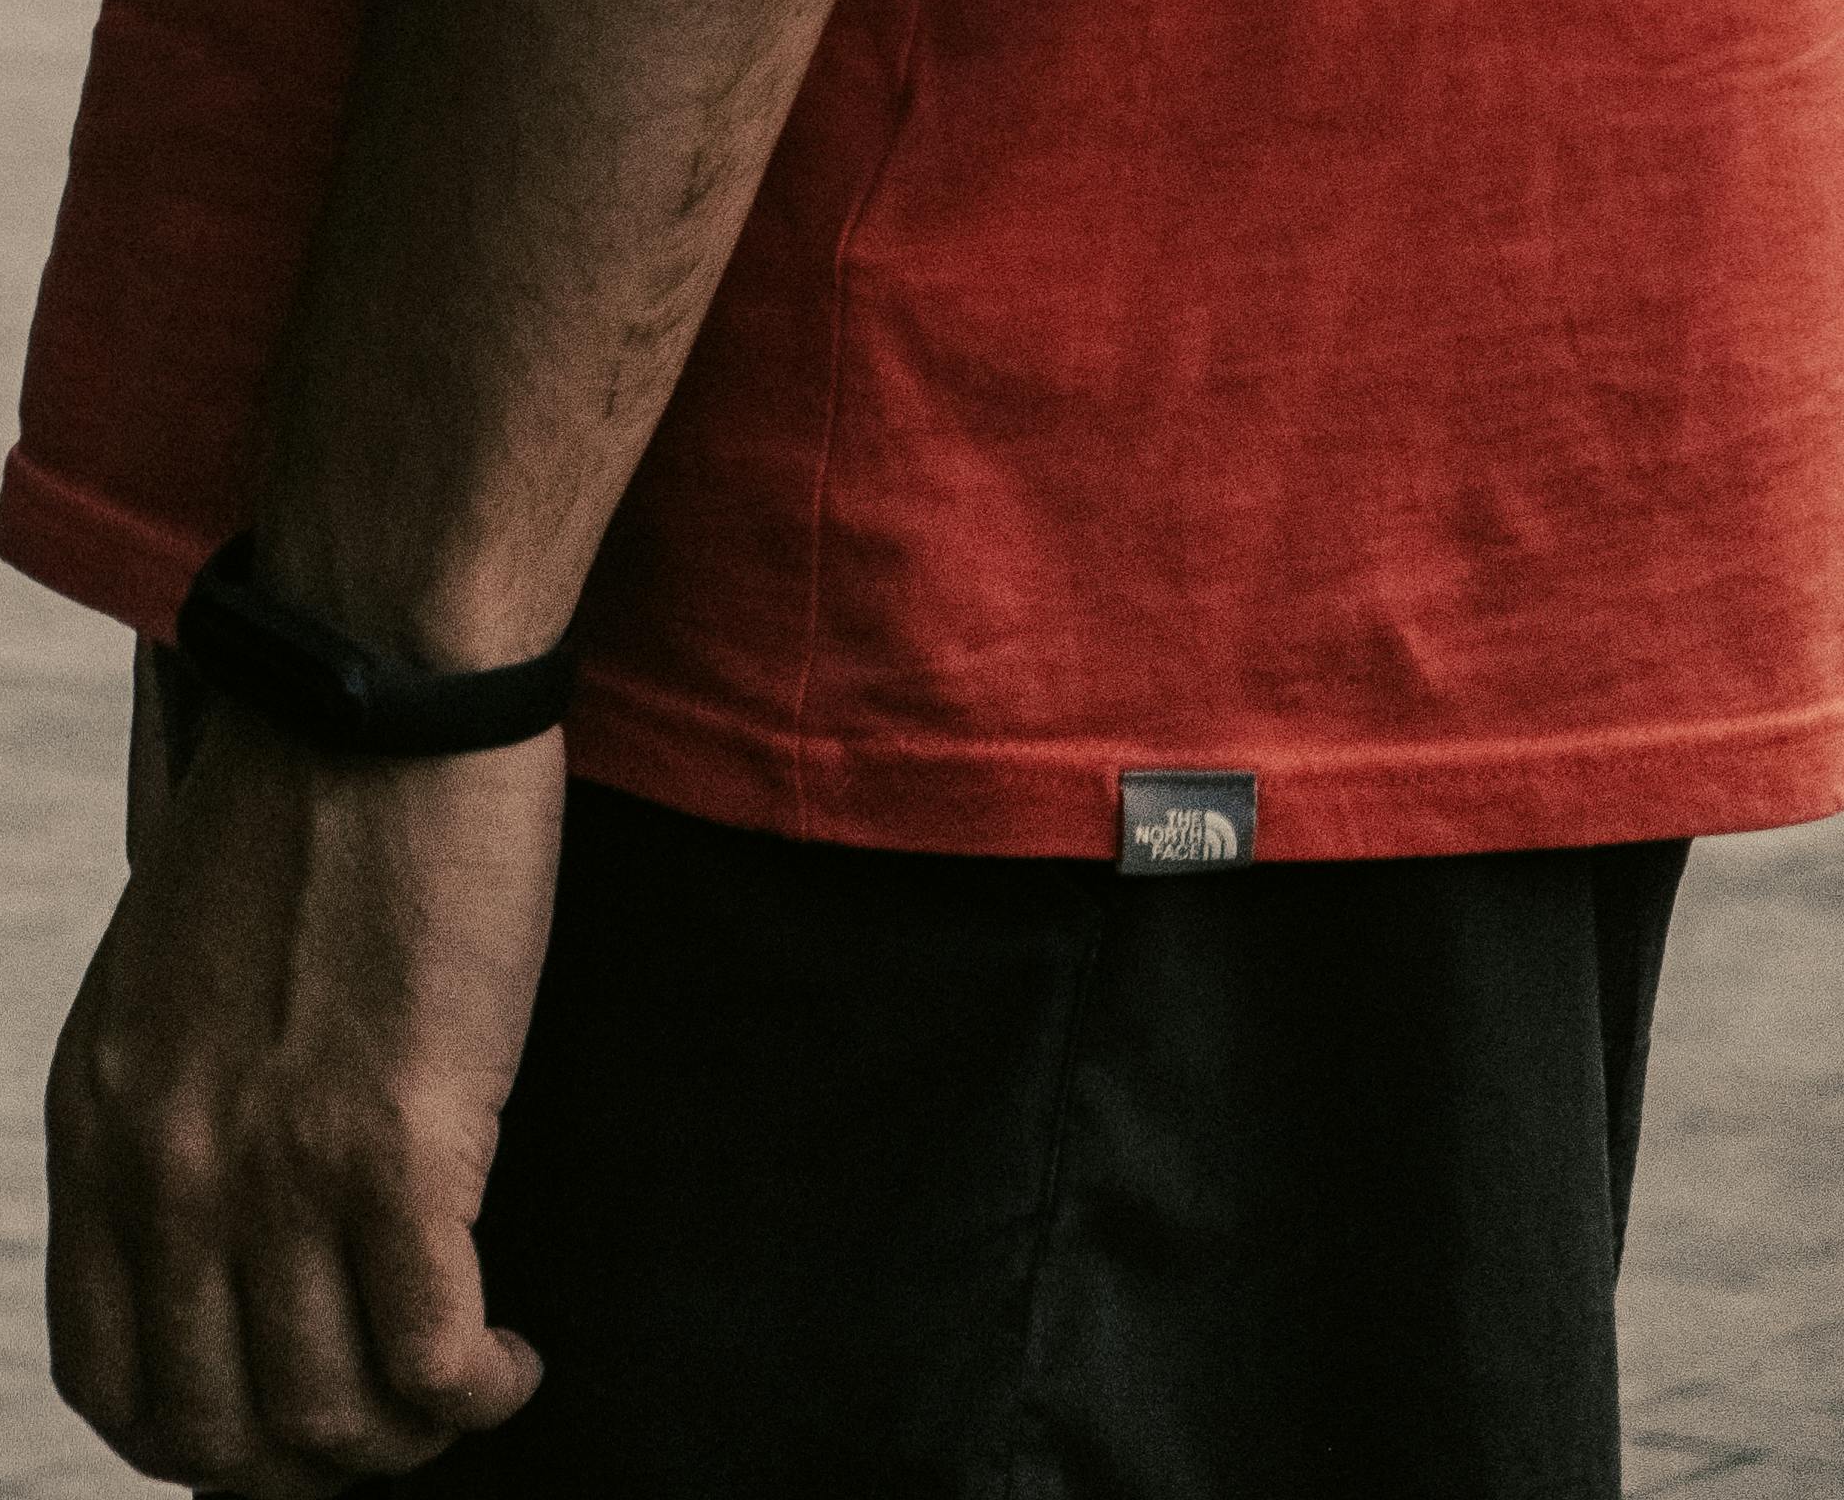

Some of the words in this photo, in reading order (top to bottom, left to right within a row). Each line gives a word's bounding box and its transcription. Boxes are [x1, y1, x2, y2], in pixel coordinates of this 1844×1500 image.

[1165, 809, 1203, 827] THE
[1135, 825, 1203, 843] NORTH
[1151, 843, 1201, 860] FACE
